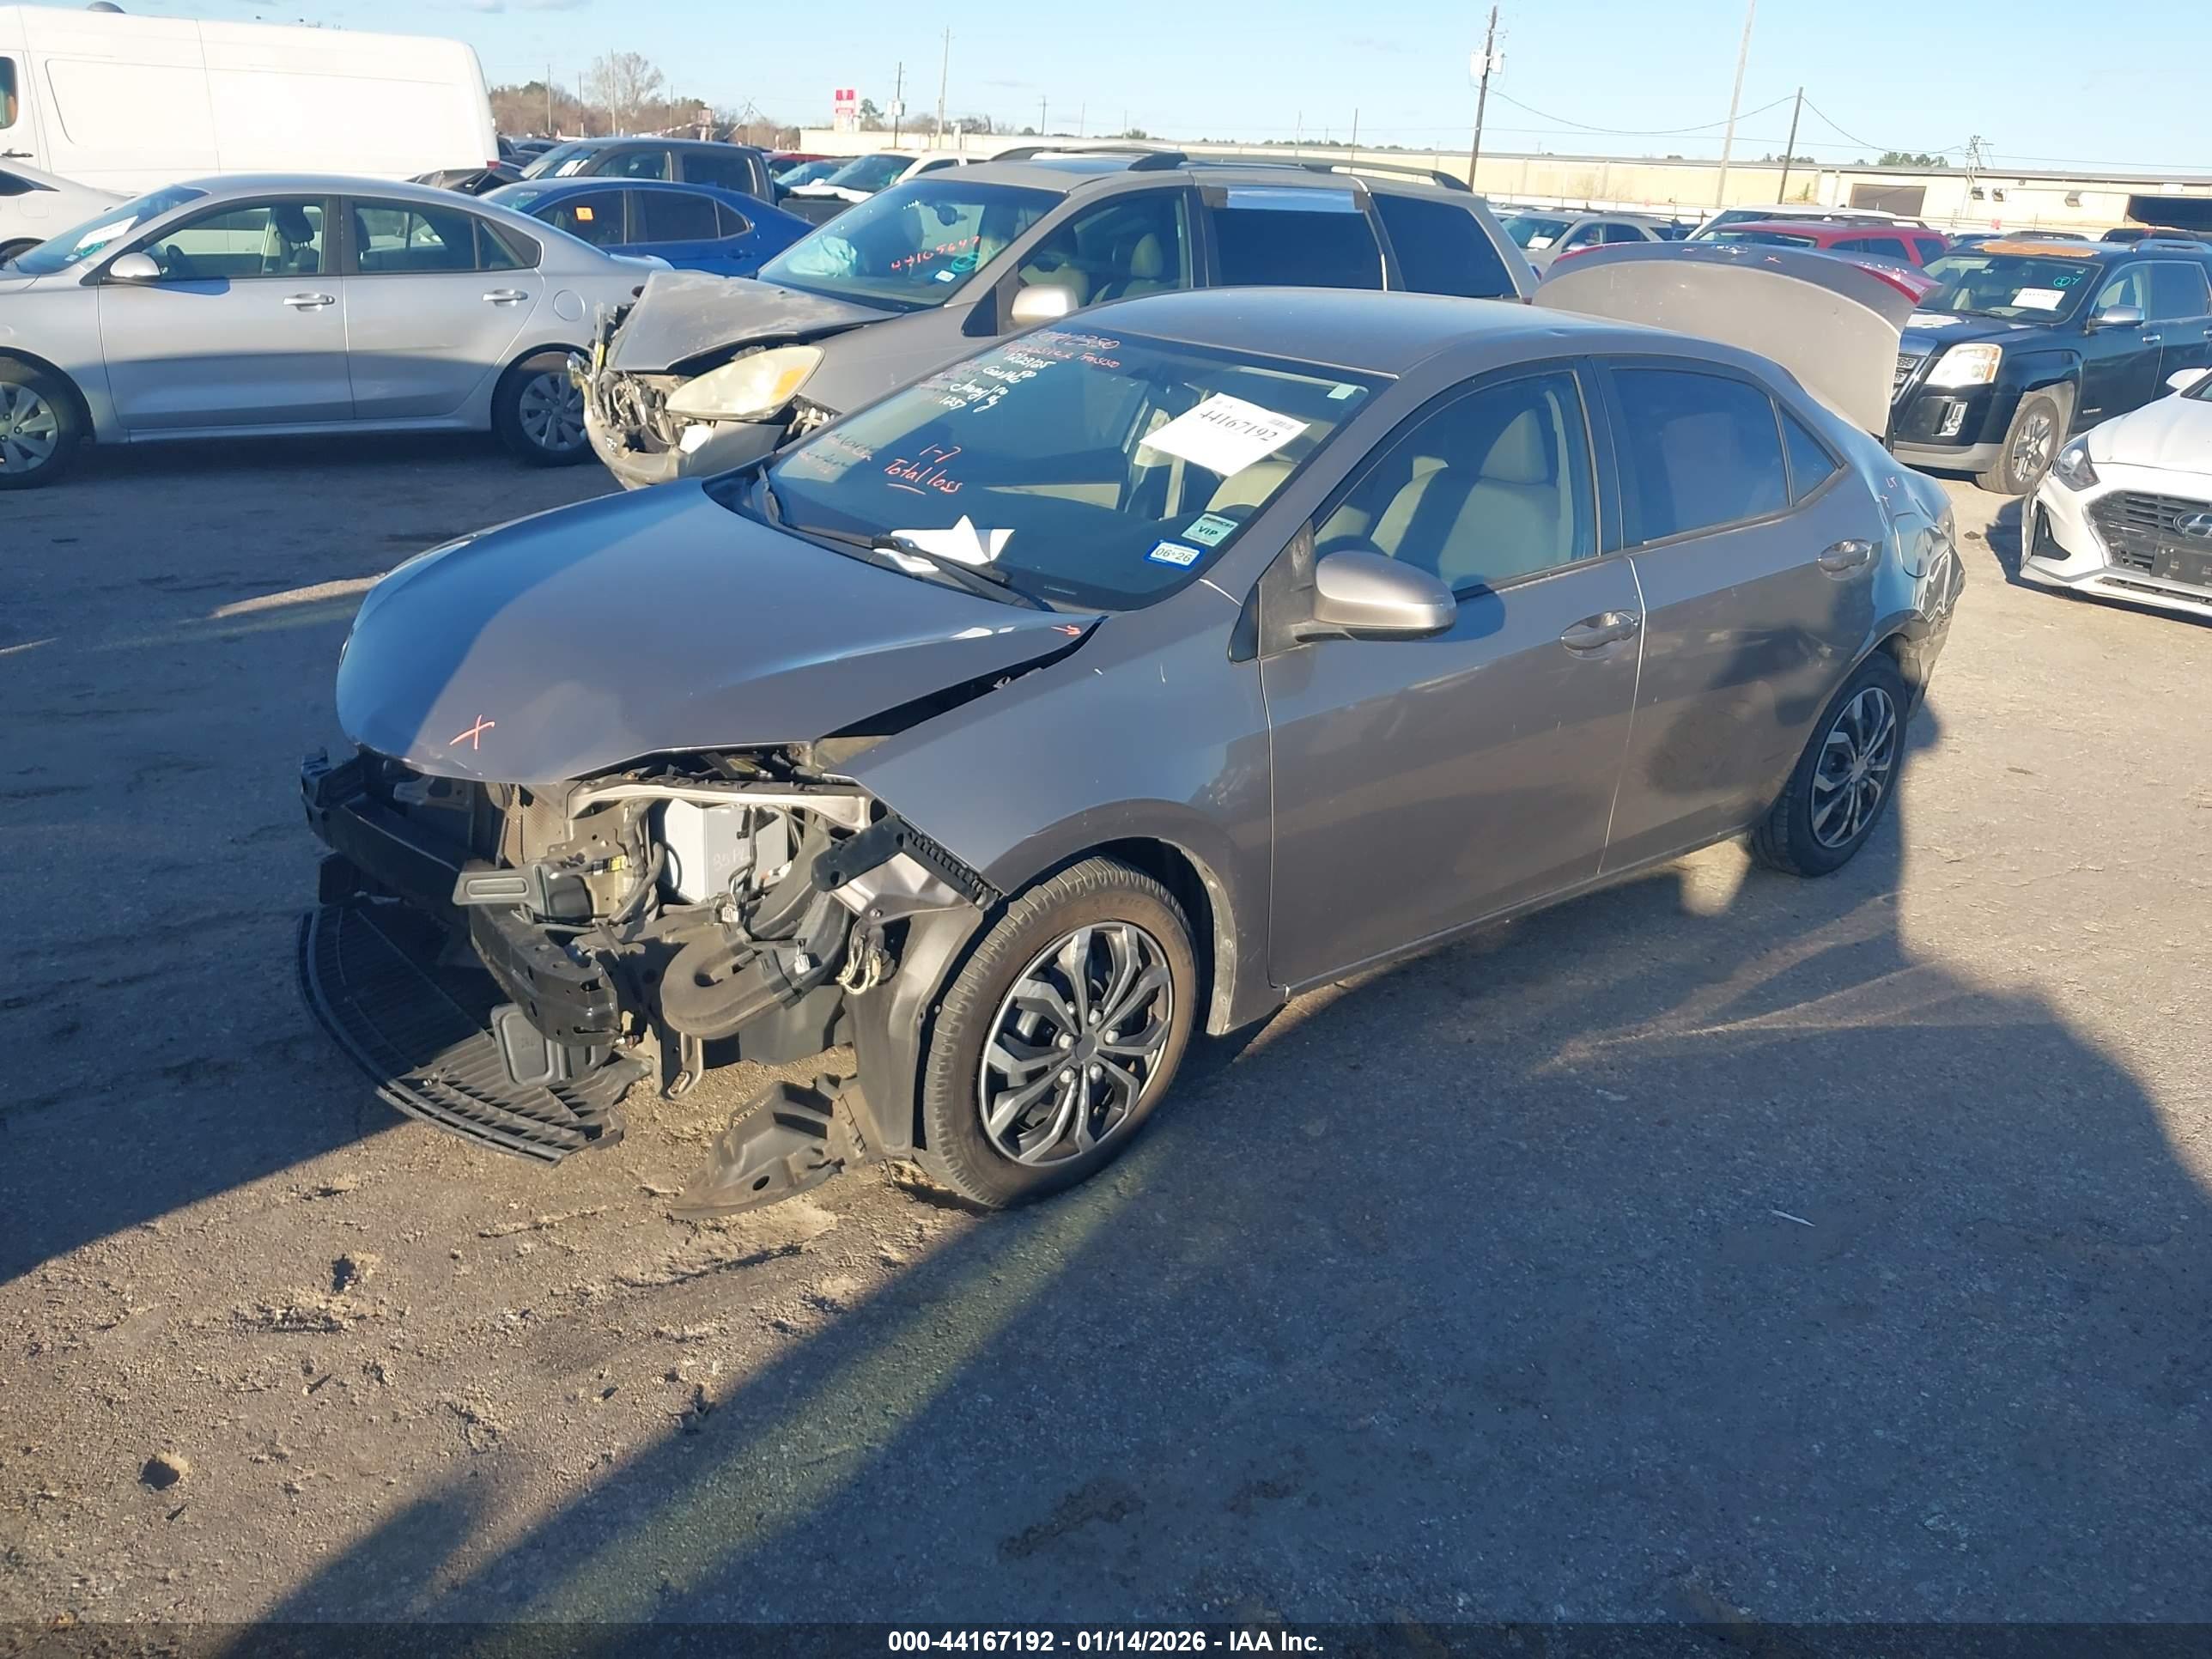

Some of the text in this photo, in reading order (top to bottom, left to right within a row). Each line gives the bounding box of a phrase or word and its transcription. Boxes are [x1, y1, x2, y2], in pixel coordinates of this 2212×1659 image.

[1199, 410, 1278, 441] 44167192
[919, 443, 962, 463] 1-7
[884, 459, 964, 493] Total loss
[1198, 526, 1218, 537] VIP
[1155, 548, 1170, 557] 06
[1175, 552, 1194, 562] 26
